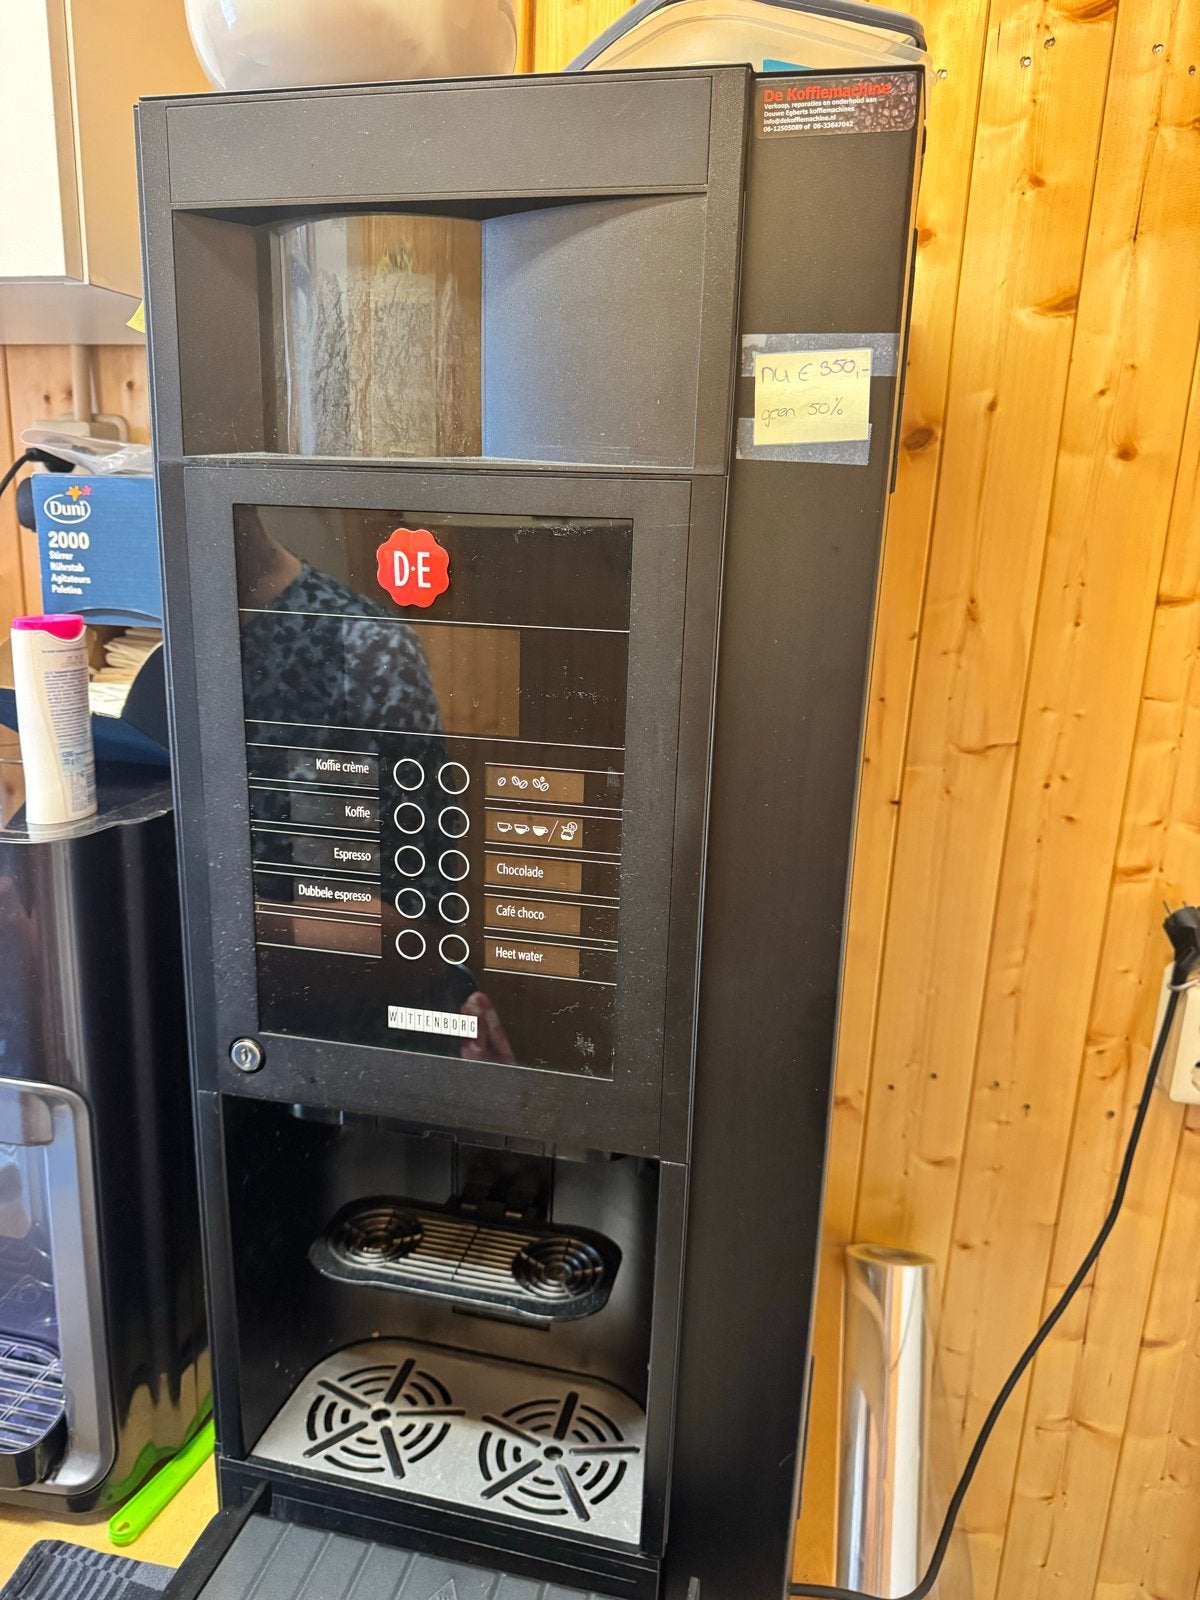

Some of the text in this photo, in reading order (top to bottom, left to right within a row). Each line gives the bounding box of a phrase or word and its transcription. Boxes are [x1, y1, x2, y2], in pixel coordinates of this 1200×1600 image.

[764, 82, 891, 103] De Koffiemachine
[791, 100, 822, 108] reparaties
[831, 97, 865, 106] onderhoud
[785, 109, 809, 117] Egberts
[809, 105, 855, 115] koffiemachines
[807, 397, 844, 416] 50%
[50, 501, 87, 517] Duni
[48, 531, 90, 550] 2000
[316, 758, 370, 774] Koffie crème
[345, 806, 371, 818] Koffie
[333, 848, 372, 862] Espresso
[496, 863, 544, 878] Chocolade
[298, 884, 372, 902] Dubbele espresso
[496, 905, 545, 920] Café choco
[495, 946, 544, 962] Heet water
[389, 1010, 476, 1033] WITTENBORG
